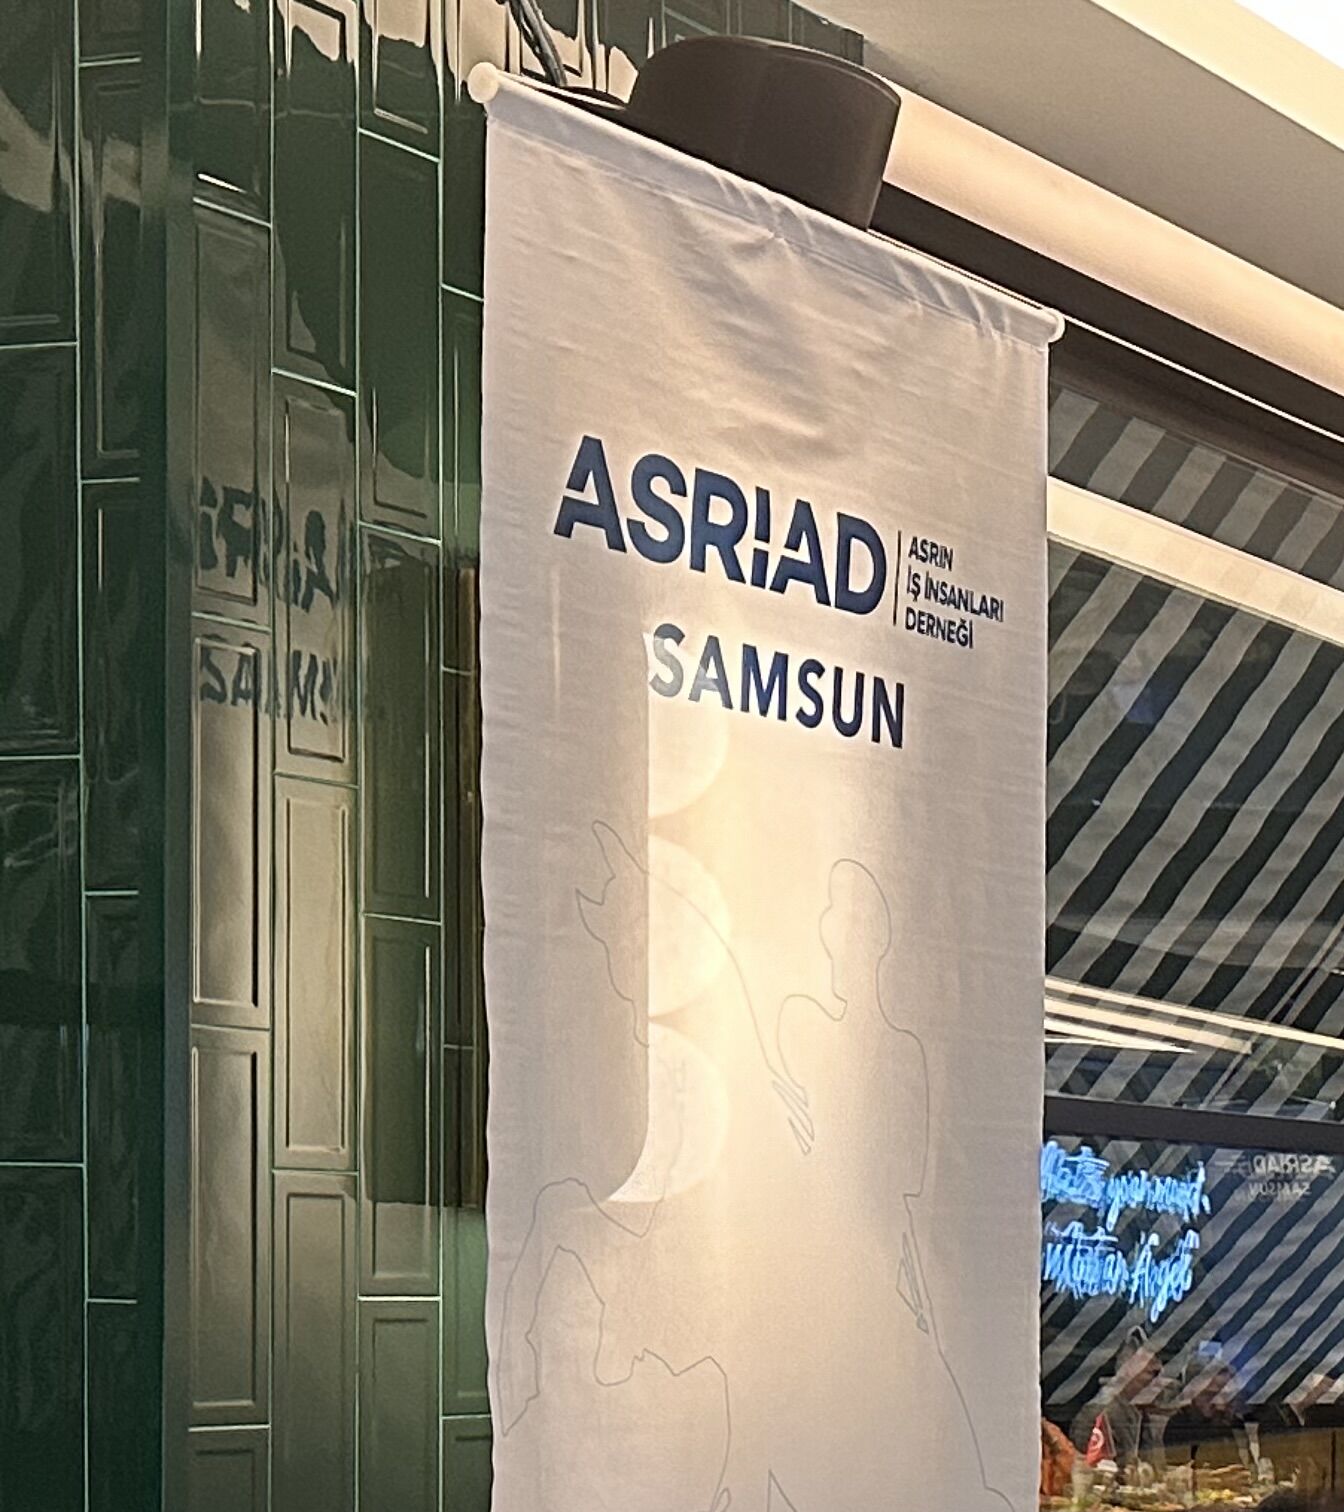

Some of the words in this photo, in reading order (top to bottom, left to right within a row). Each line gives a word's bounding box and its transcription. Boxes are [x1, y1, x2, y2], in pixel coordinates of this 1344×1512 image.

[553, 435, 887, 615] ASRIAD
[908, 536, 953, 572] ASRIN
[650, 622, 905, 748] SAMSUN
